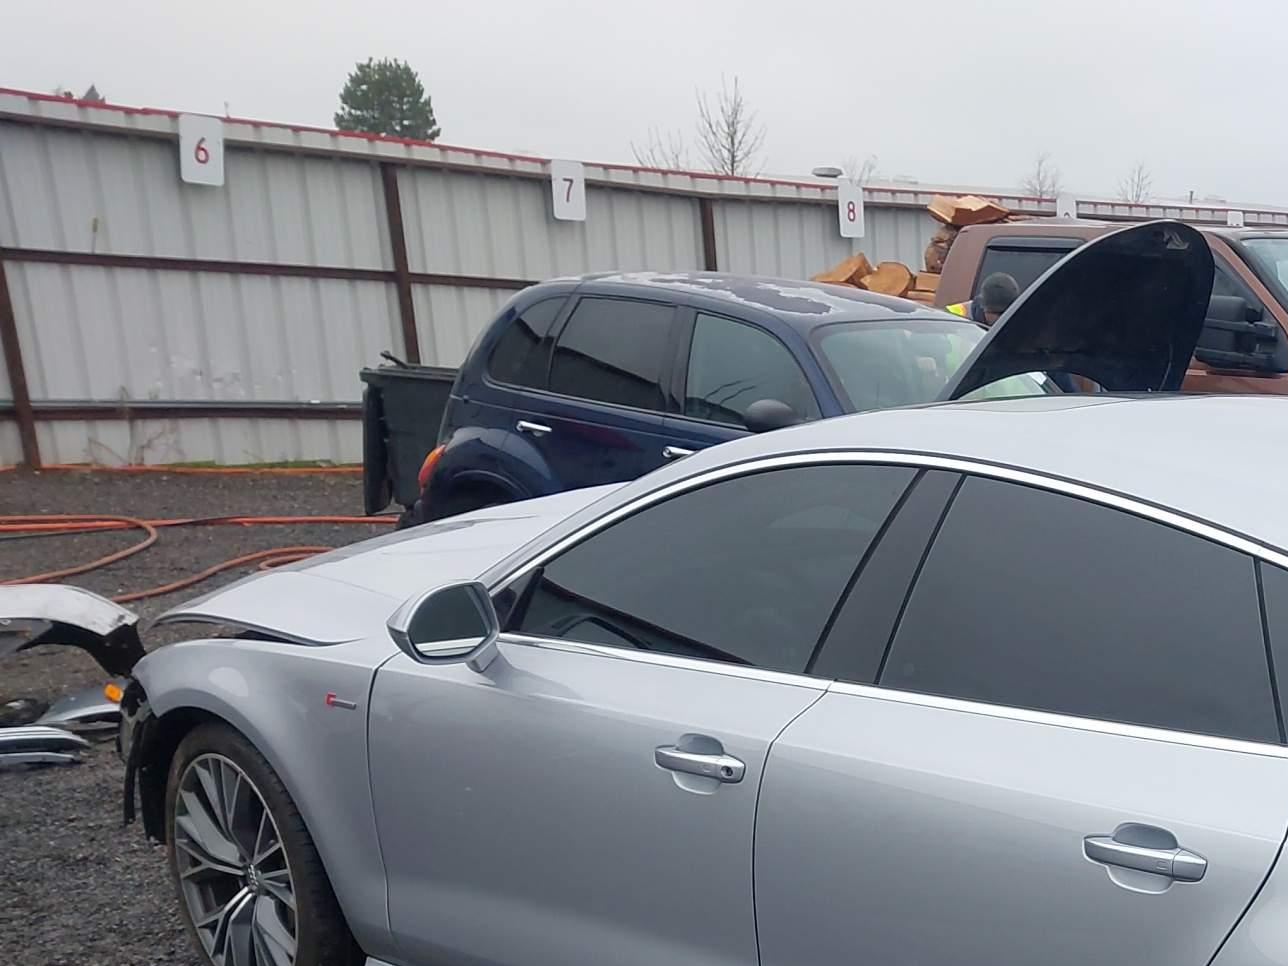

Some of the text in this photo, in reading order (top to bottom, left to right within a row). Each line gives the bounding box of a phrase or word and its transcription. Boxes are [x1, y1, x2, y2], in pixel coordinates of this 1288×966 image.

[194, 136, 210, 165] 6
[562, 177, 574, 204] 7
[847, 200, 856, 222] 8
